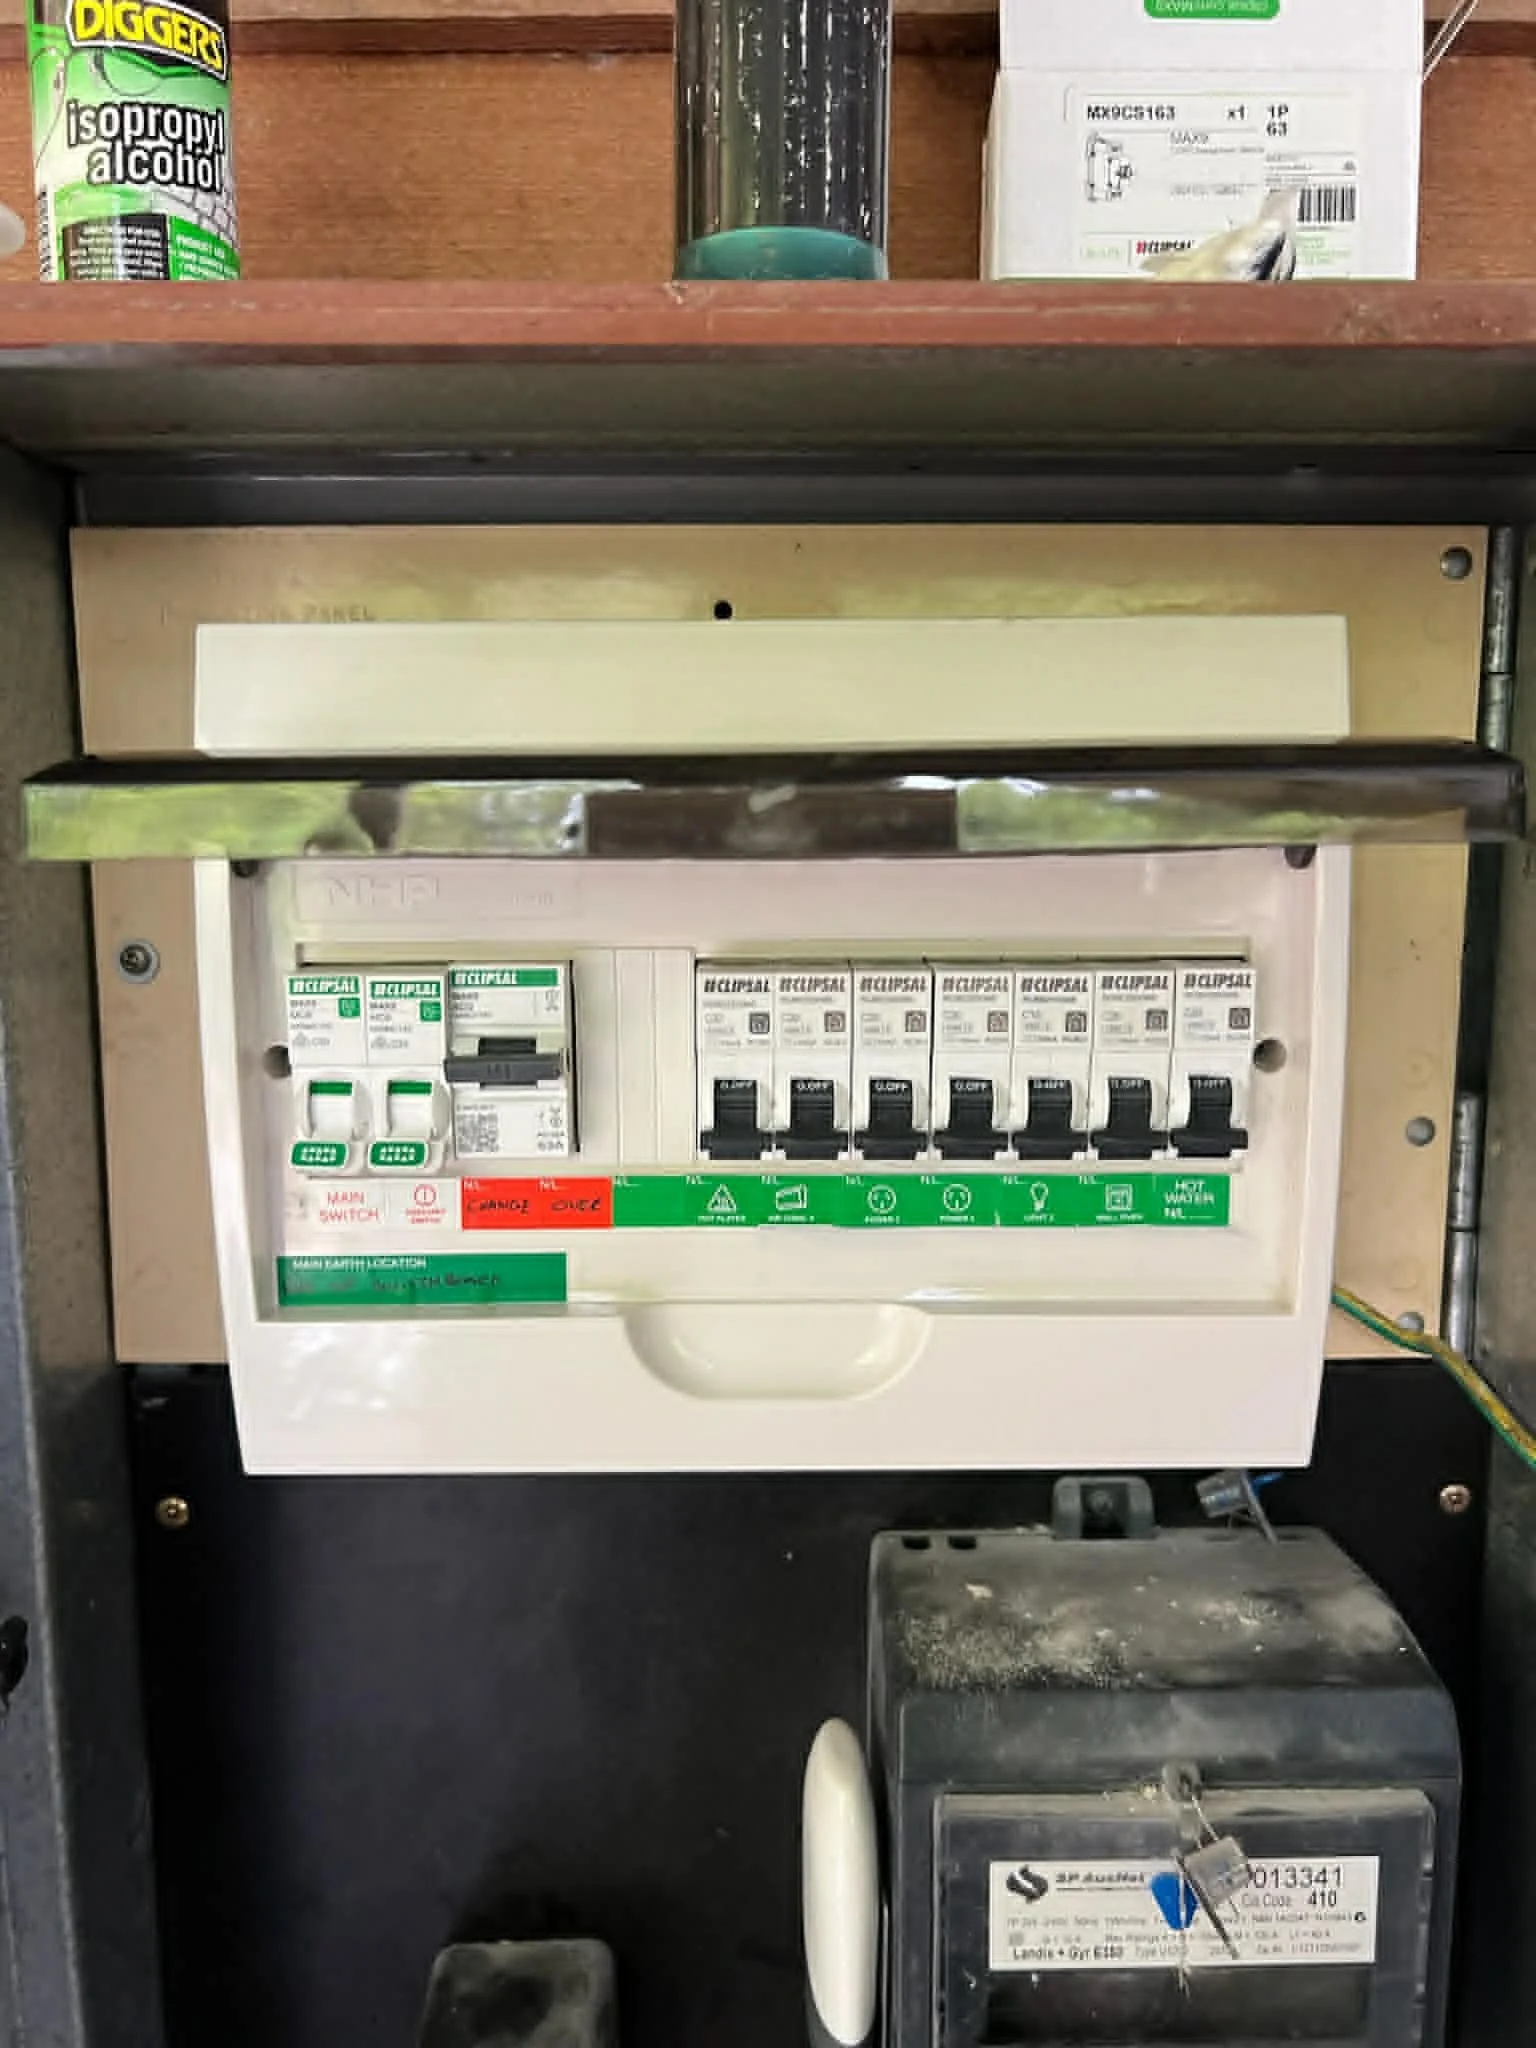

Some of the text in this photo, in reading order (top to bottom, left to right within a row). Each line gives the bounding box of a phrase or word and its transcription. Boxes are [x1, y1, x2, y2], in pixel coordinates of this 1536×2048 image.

[73, 0, 223, 71] DIGGERS
[1086, 104, 1290, 121] MX9CS163 x1 1P
[67, 100, 225, 154] isopropyl
[1265, 121, 1288, 137] 63
[86, 142, 224, 194] alcohol
[717, 977, 771, 993] CLIPSAL
[792, 975, 846, 993] CLIPSAL
[873, 975, 926, 993] CLIPSAL
[955, 975, 1009, 993] CLIPSAL
[1033, 976, 1088, 994] CLIPSAL
[1113, 975, 1168, 991] CLIPSAL
[1196, 972, 1251, 990] CLIPSAL
[1174, 1180, 1205, 1192] HOT
[328, 1191, 365, 1205] MAIN
[1163, 1191, 1215, 1205] WATER
[319, 1207, 378, 1224] SWITCH
[367, 1255, 428, 1270] LOCATION
[1248, 1865, 1345, 1889] 013341
[1308, 1889, 1338, 1908] 410
[1014, 1947, 1054, 1961] Landis
